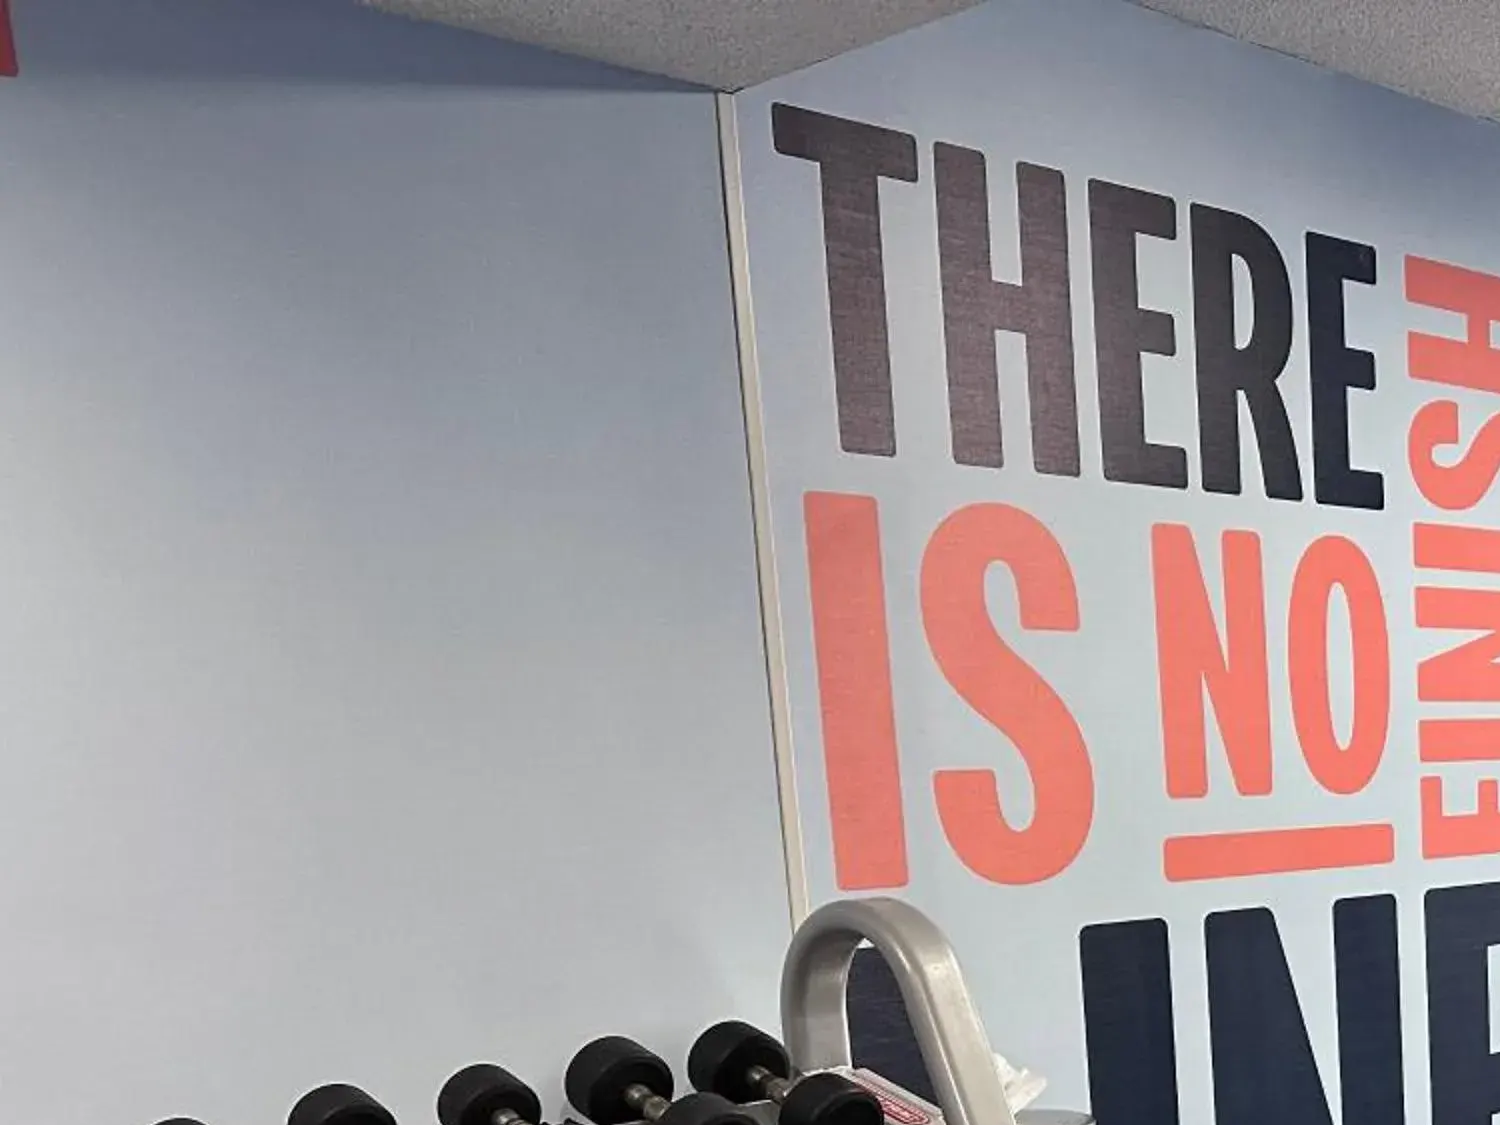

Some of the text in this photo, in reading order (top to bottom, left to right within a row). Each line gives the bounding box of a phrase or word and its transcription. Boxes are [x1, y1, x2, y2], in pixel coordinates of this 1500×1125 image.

[771, 102, 1385, 511] THERE
[803, 491, 1390, 890] IS NO
